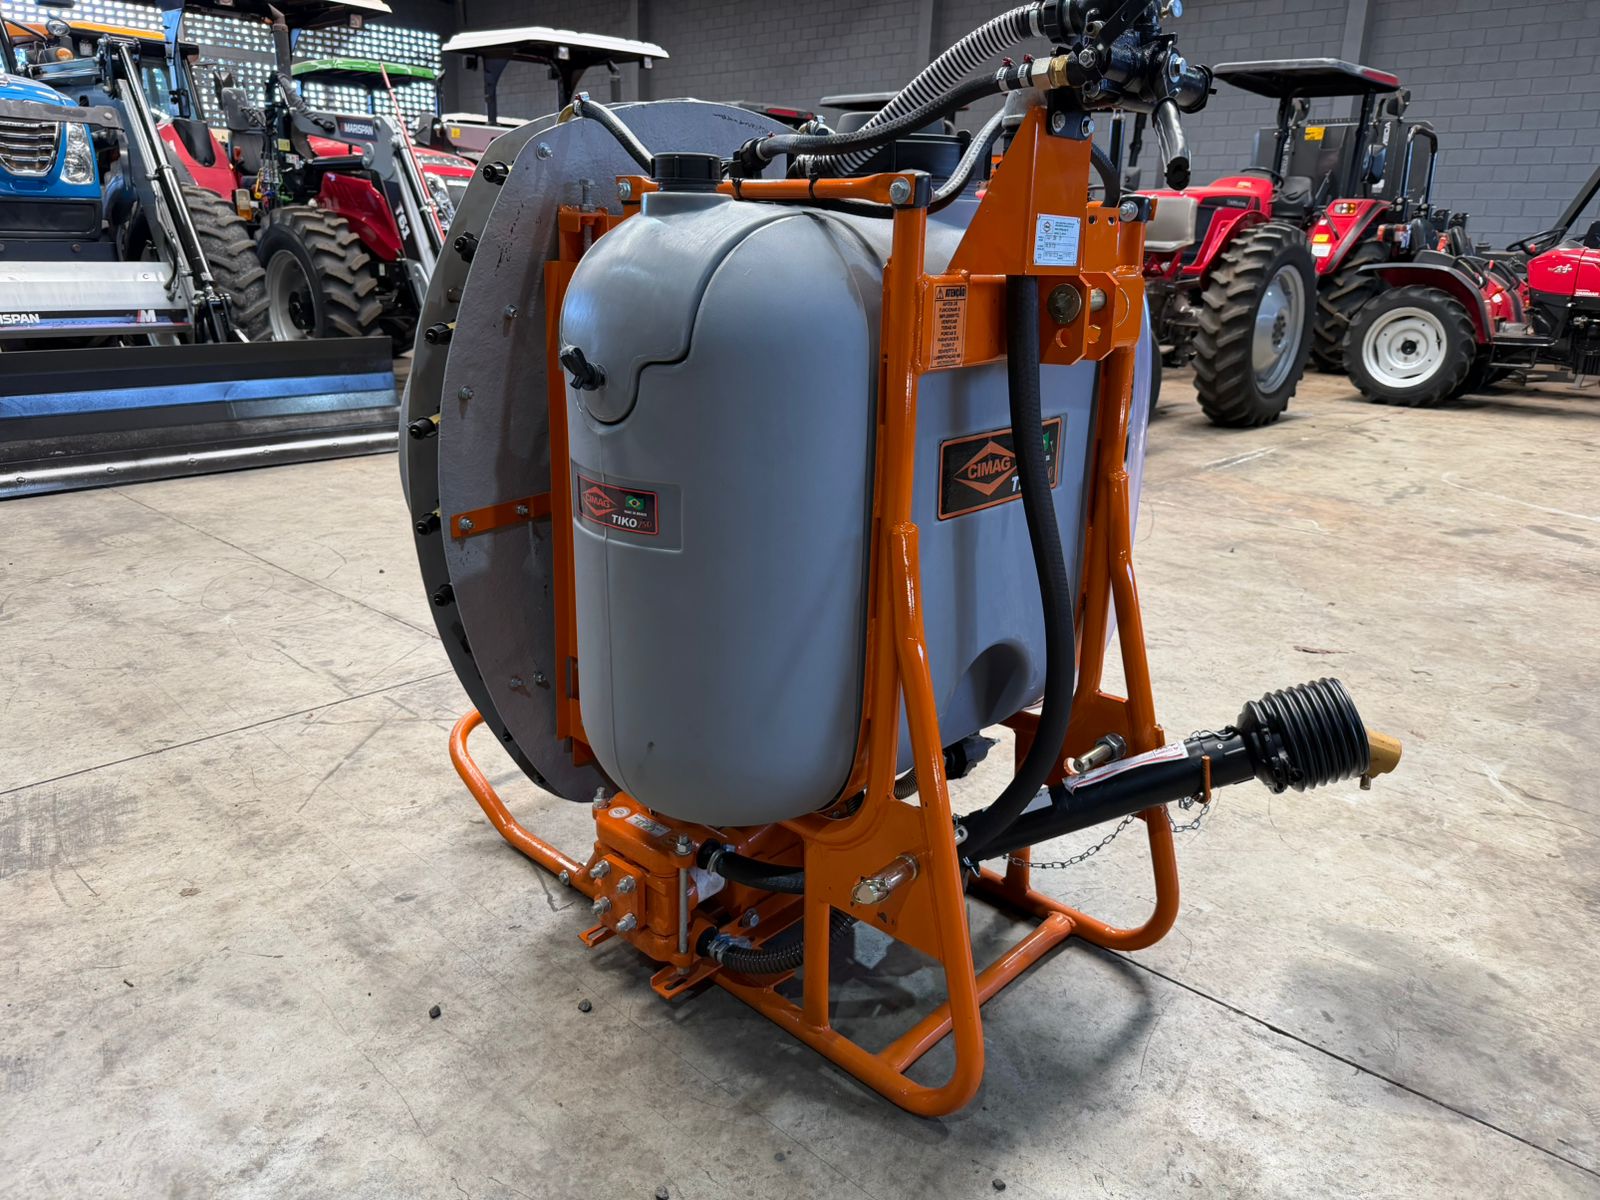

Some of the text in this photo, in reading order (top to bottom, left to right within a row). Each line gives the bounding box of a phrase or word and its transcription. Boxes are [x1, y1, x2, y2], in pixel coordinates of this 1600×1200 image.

[967, 457, 1011, 479] CIMAG
[585, 493, 610, 508] CIMAG
[611, 514, 638, 528] TIKO
